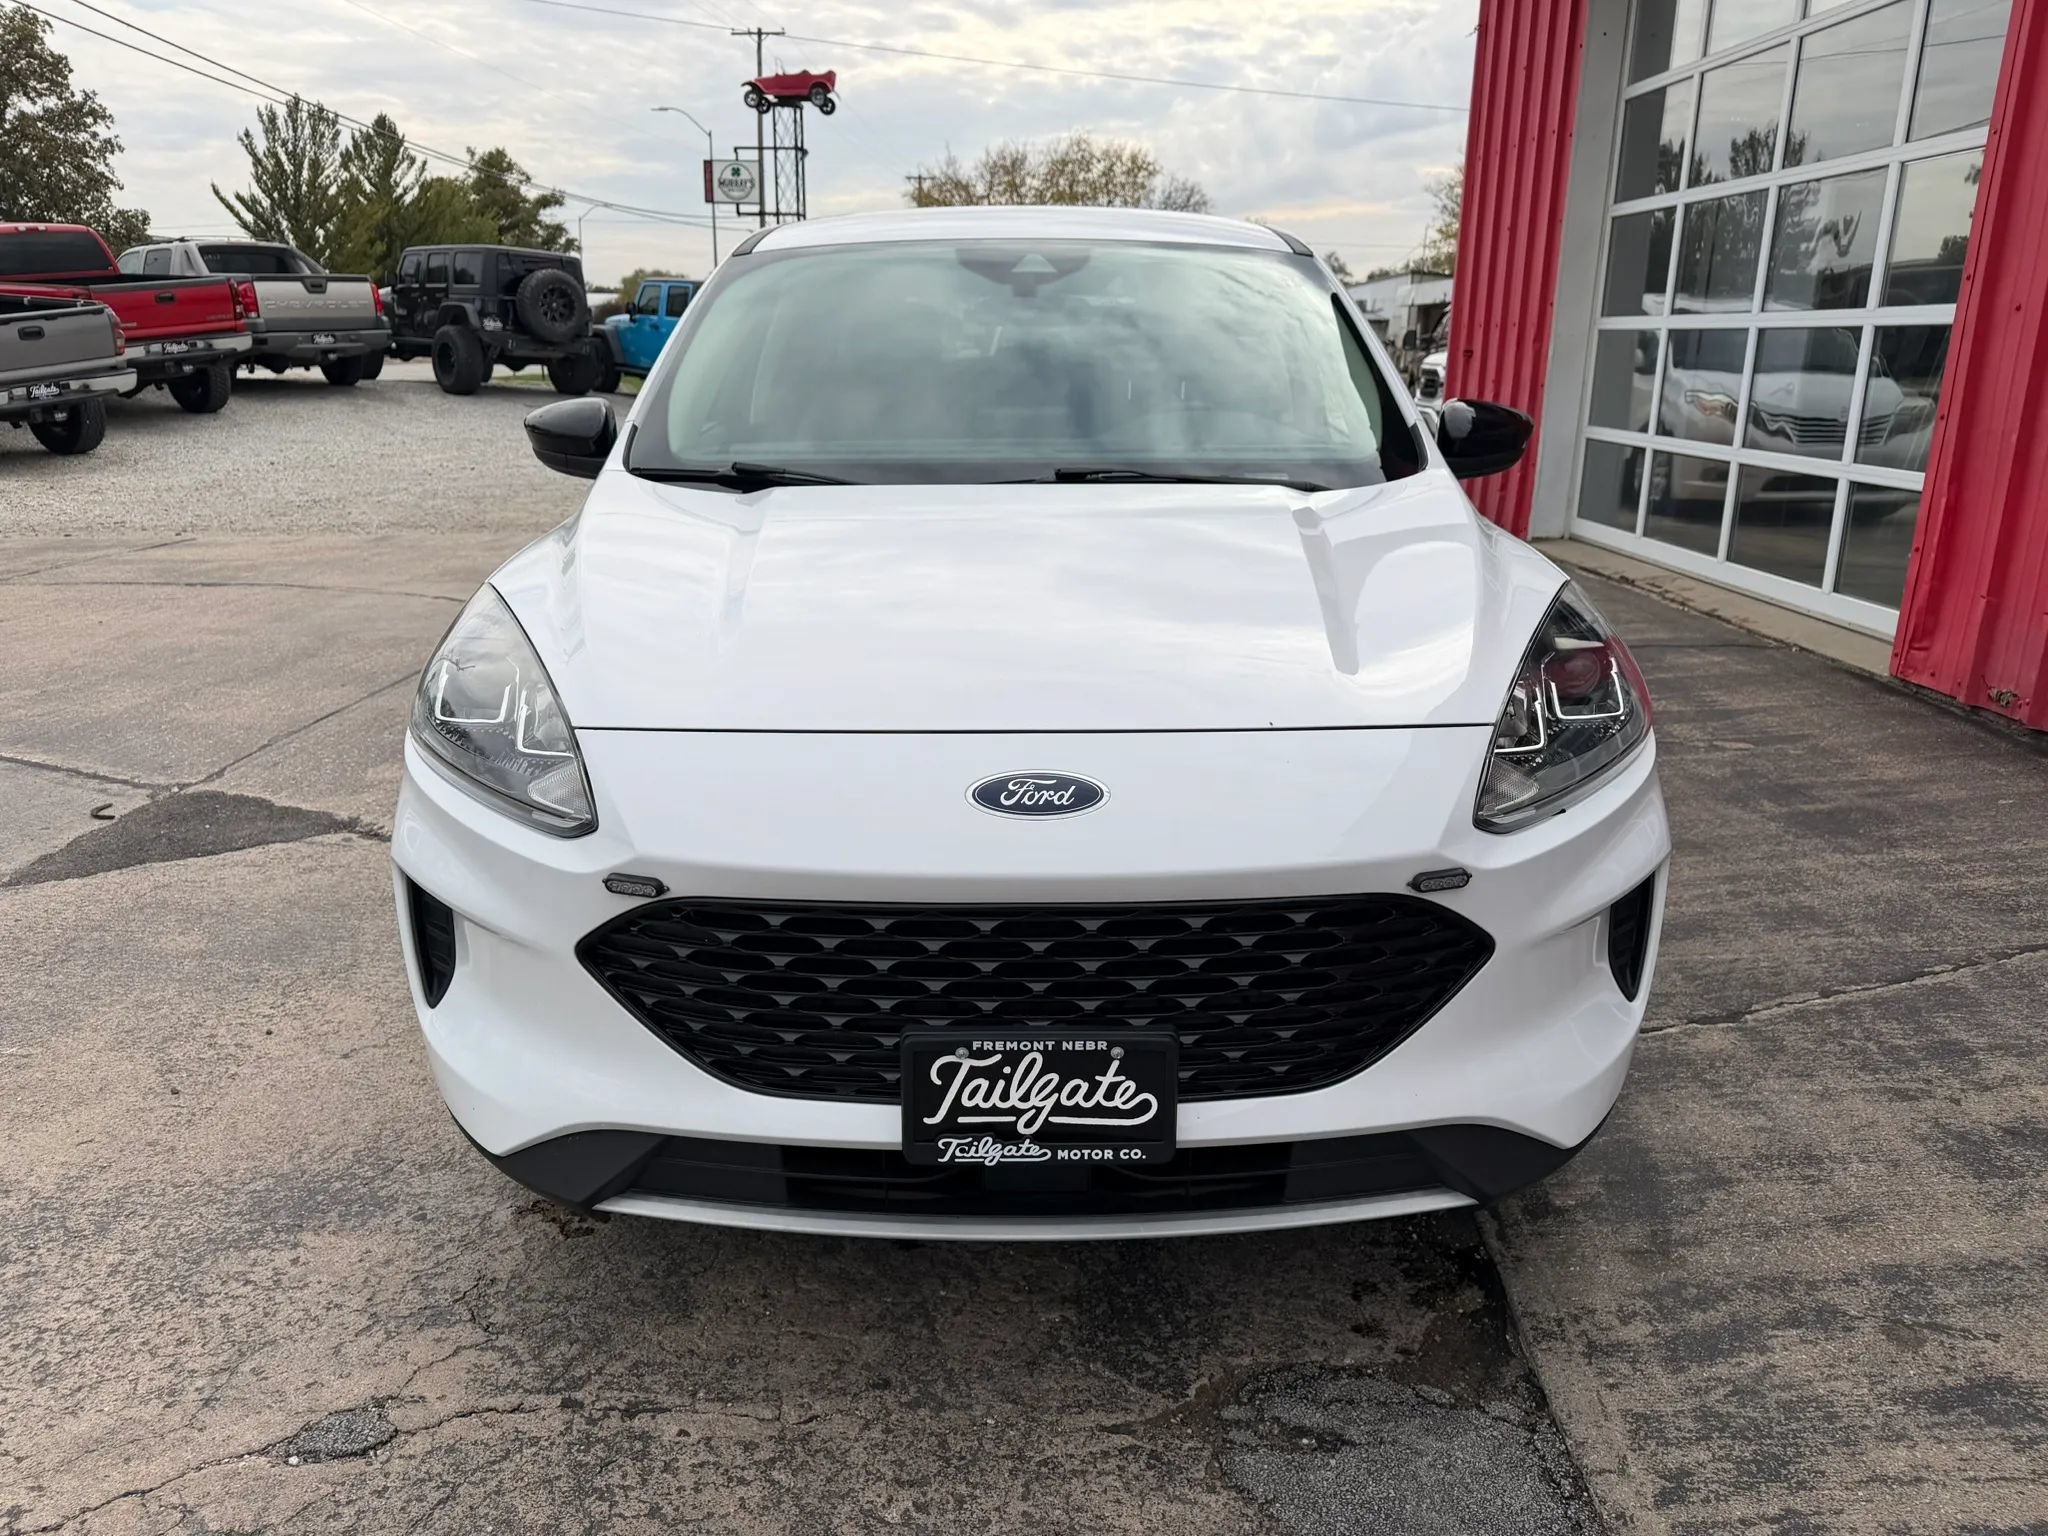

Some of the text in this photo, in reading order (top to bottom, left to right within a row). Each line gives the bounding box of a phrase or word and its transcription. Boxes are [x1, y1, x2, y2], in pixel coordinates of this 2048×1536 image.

[1000, 778, 1077, 806] Ford
[972, 1040, 1109, 1051] FREMONT NEBR
[923, 1051, 1158, 1135] Tailgate
[937, 1136, 1147, 1166] Tailgate MOTOR CO.
